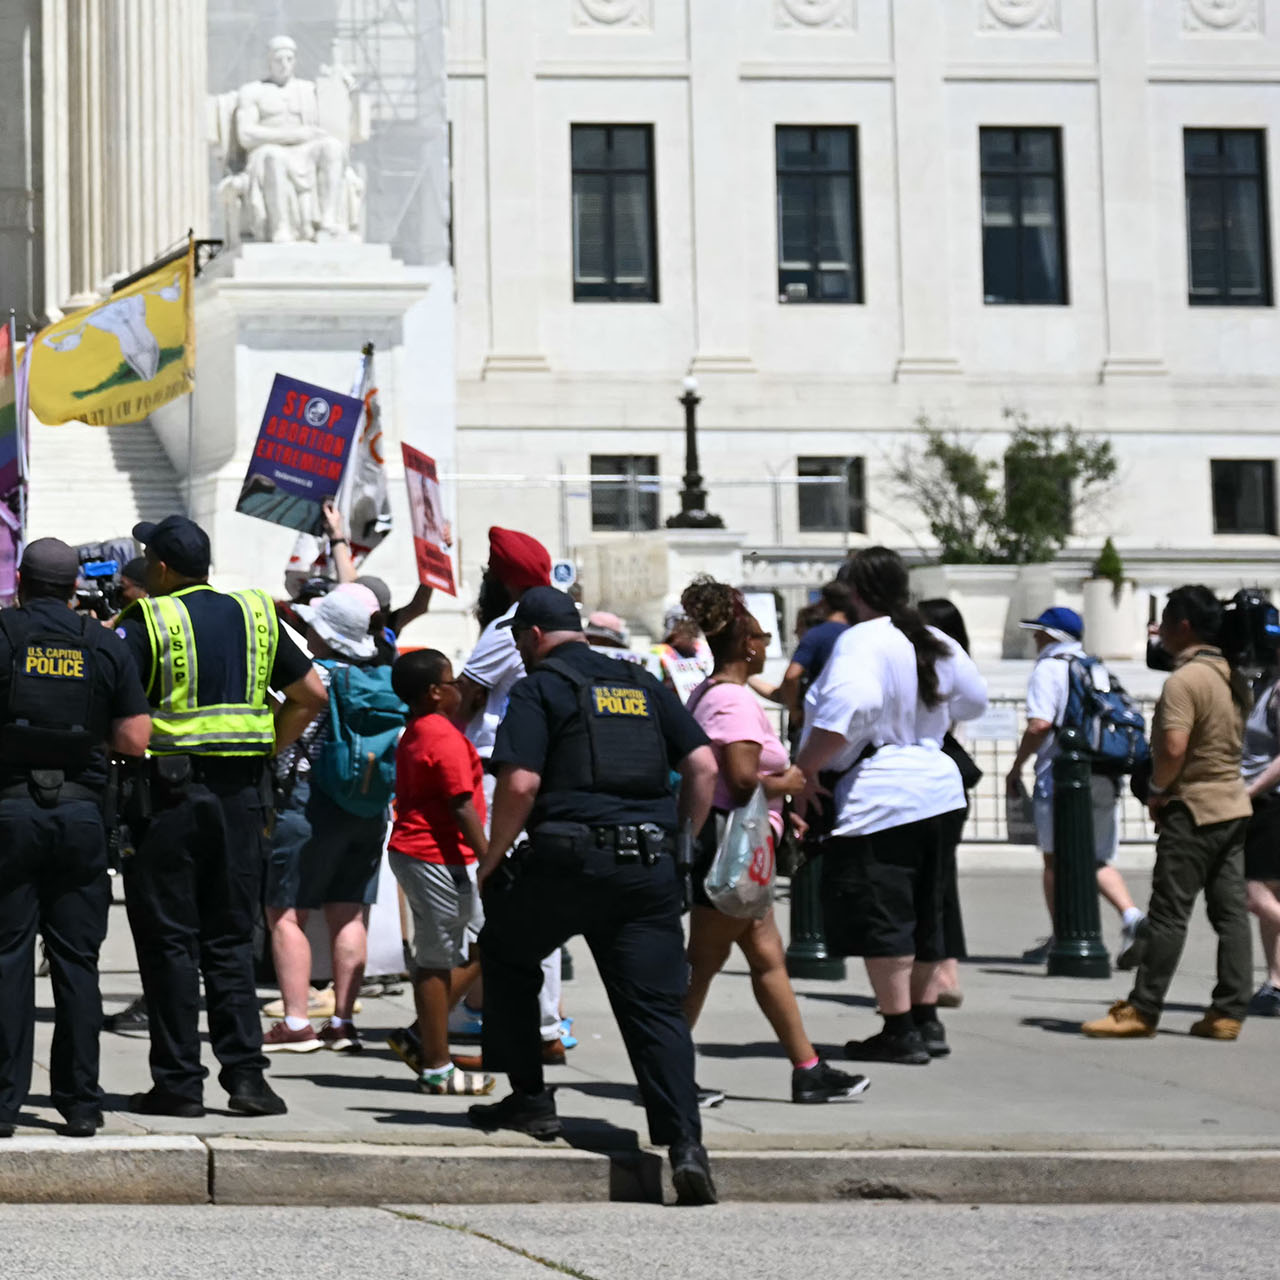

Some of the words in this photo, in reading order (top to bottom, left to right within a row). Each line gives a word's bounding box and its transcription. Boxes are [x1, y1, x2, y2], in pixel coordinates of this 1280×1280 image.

[266, 415, 346, 457] ABORTION
[256, 438, 343, 481] EXTREMISM
[25, 657, 85, 678] POLICE
[27, 647, 44, 658] U.S.
[45, 648, 85, 661] CAPITOL
[169, 625, 186, 683] USCP
[255, 611, 268, 690] POLICE
[596, 696, 649, 717] POLICE
